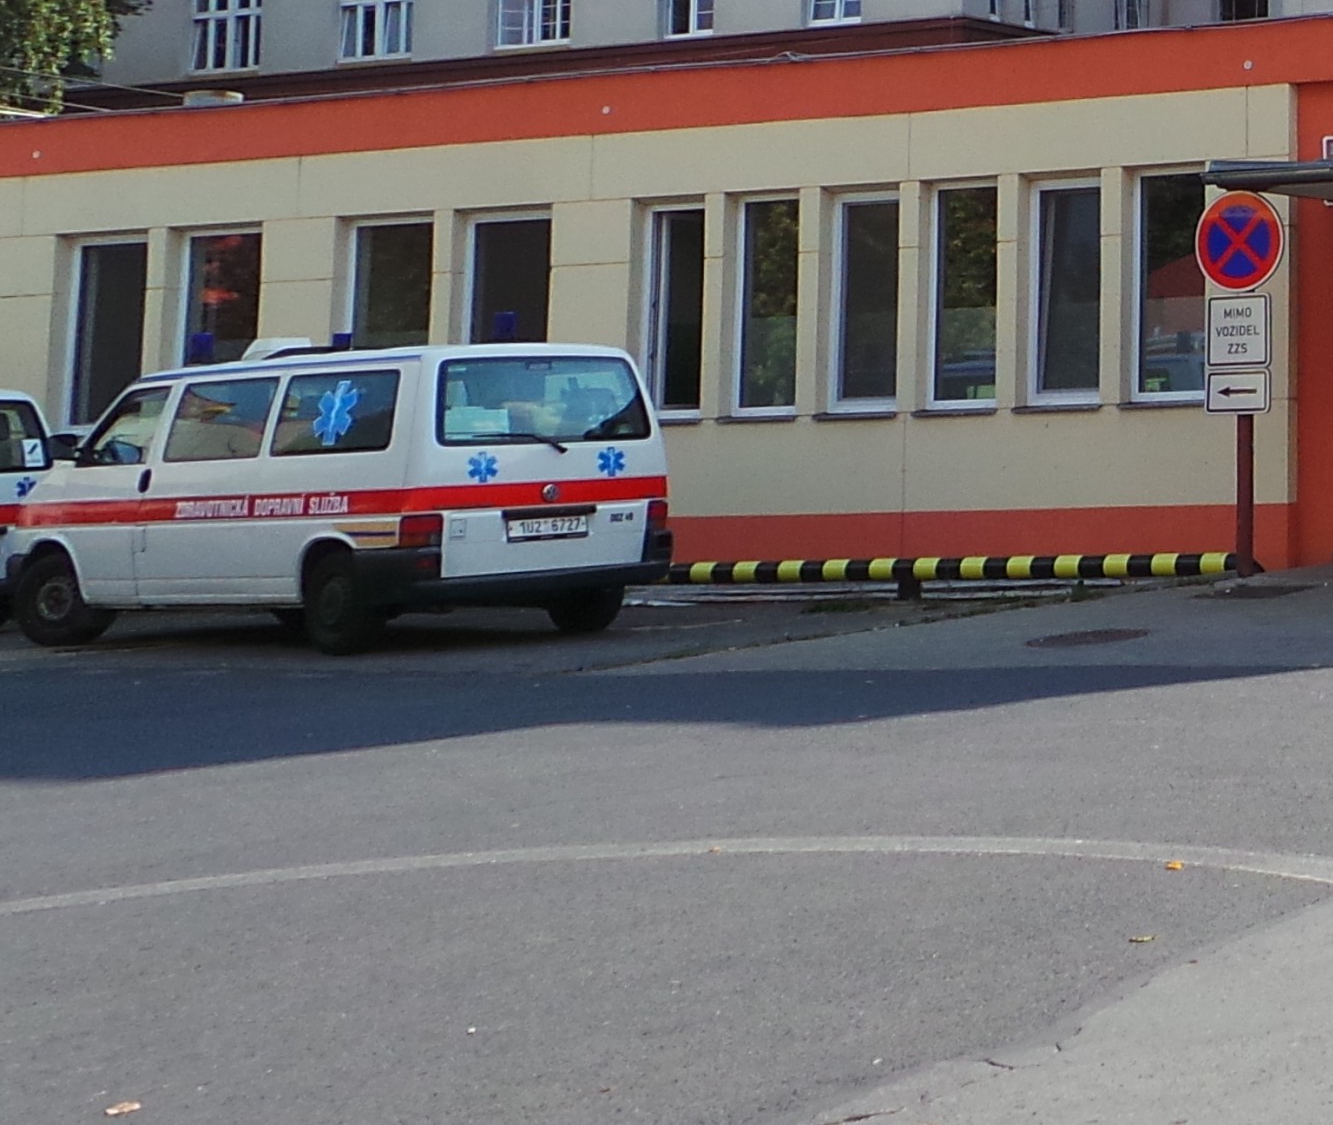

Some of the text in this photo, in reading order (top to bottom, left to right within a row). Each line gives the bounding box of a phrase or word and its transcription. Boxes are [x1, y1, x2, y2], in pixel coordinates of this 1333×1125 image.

[1223, 307, 1252, 319] MIMO
[1215, 325, 1260, 337] VOZIDEL
[1227, 343, 1248, 354] ZZS
[254, 493, 305, 516] DOPRAVNÍ
[308, 492, 348, 514] SLUŽBA
